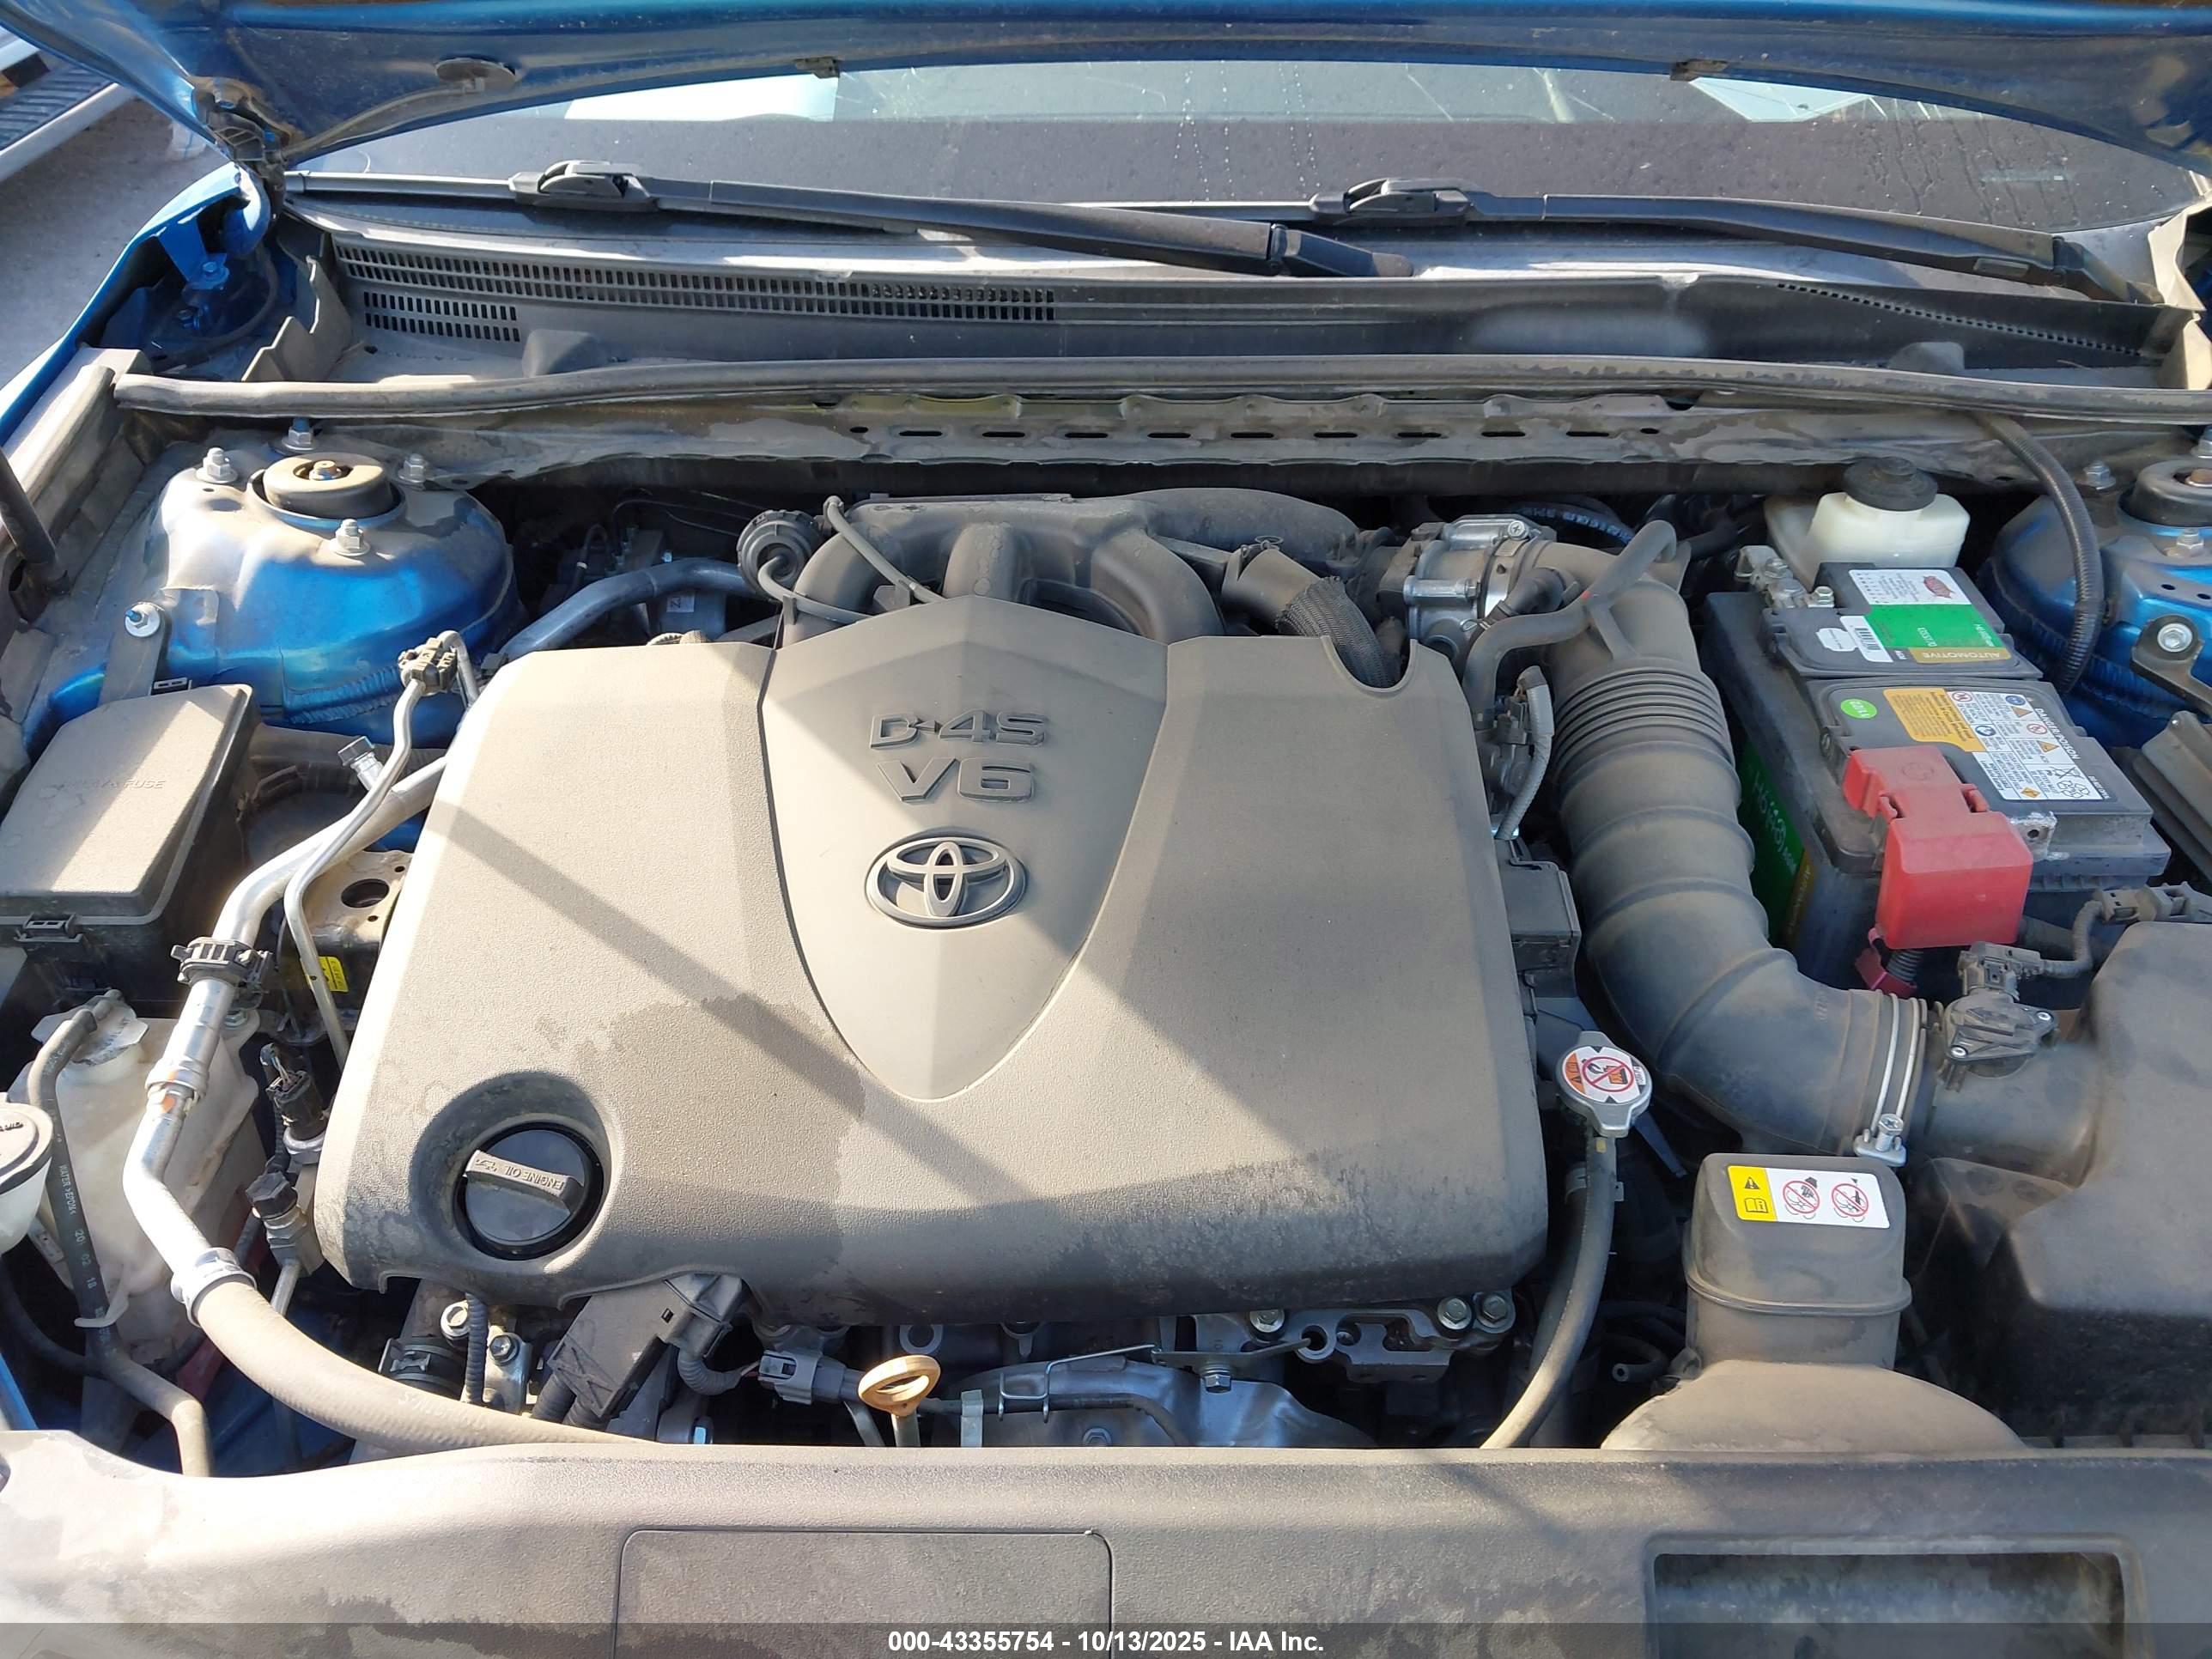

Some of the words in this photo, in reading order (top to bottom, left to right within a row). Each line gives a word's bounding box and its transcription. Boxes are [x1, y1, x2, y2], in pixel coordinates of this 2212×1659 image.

[124, 779, 167, 789] FUSE
[876, 757, 1036, 802] V6
[505, 1165, 521, 1178] OIL
[522, 1171, 564, 1191] ENGINE
